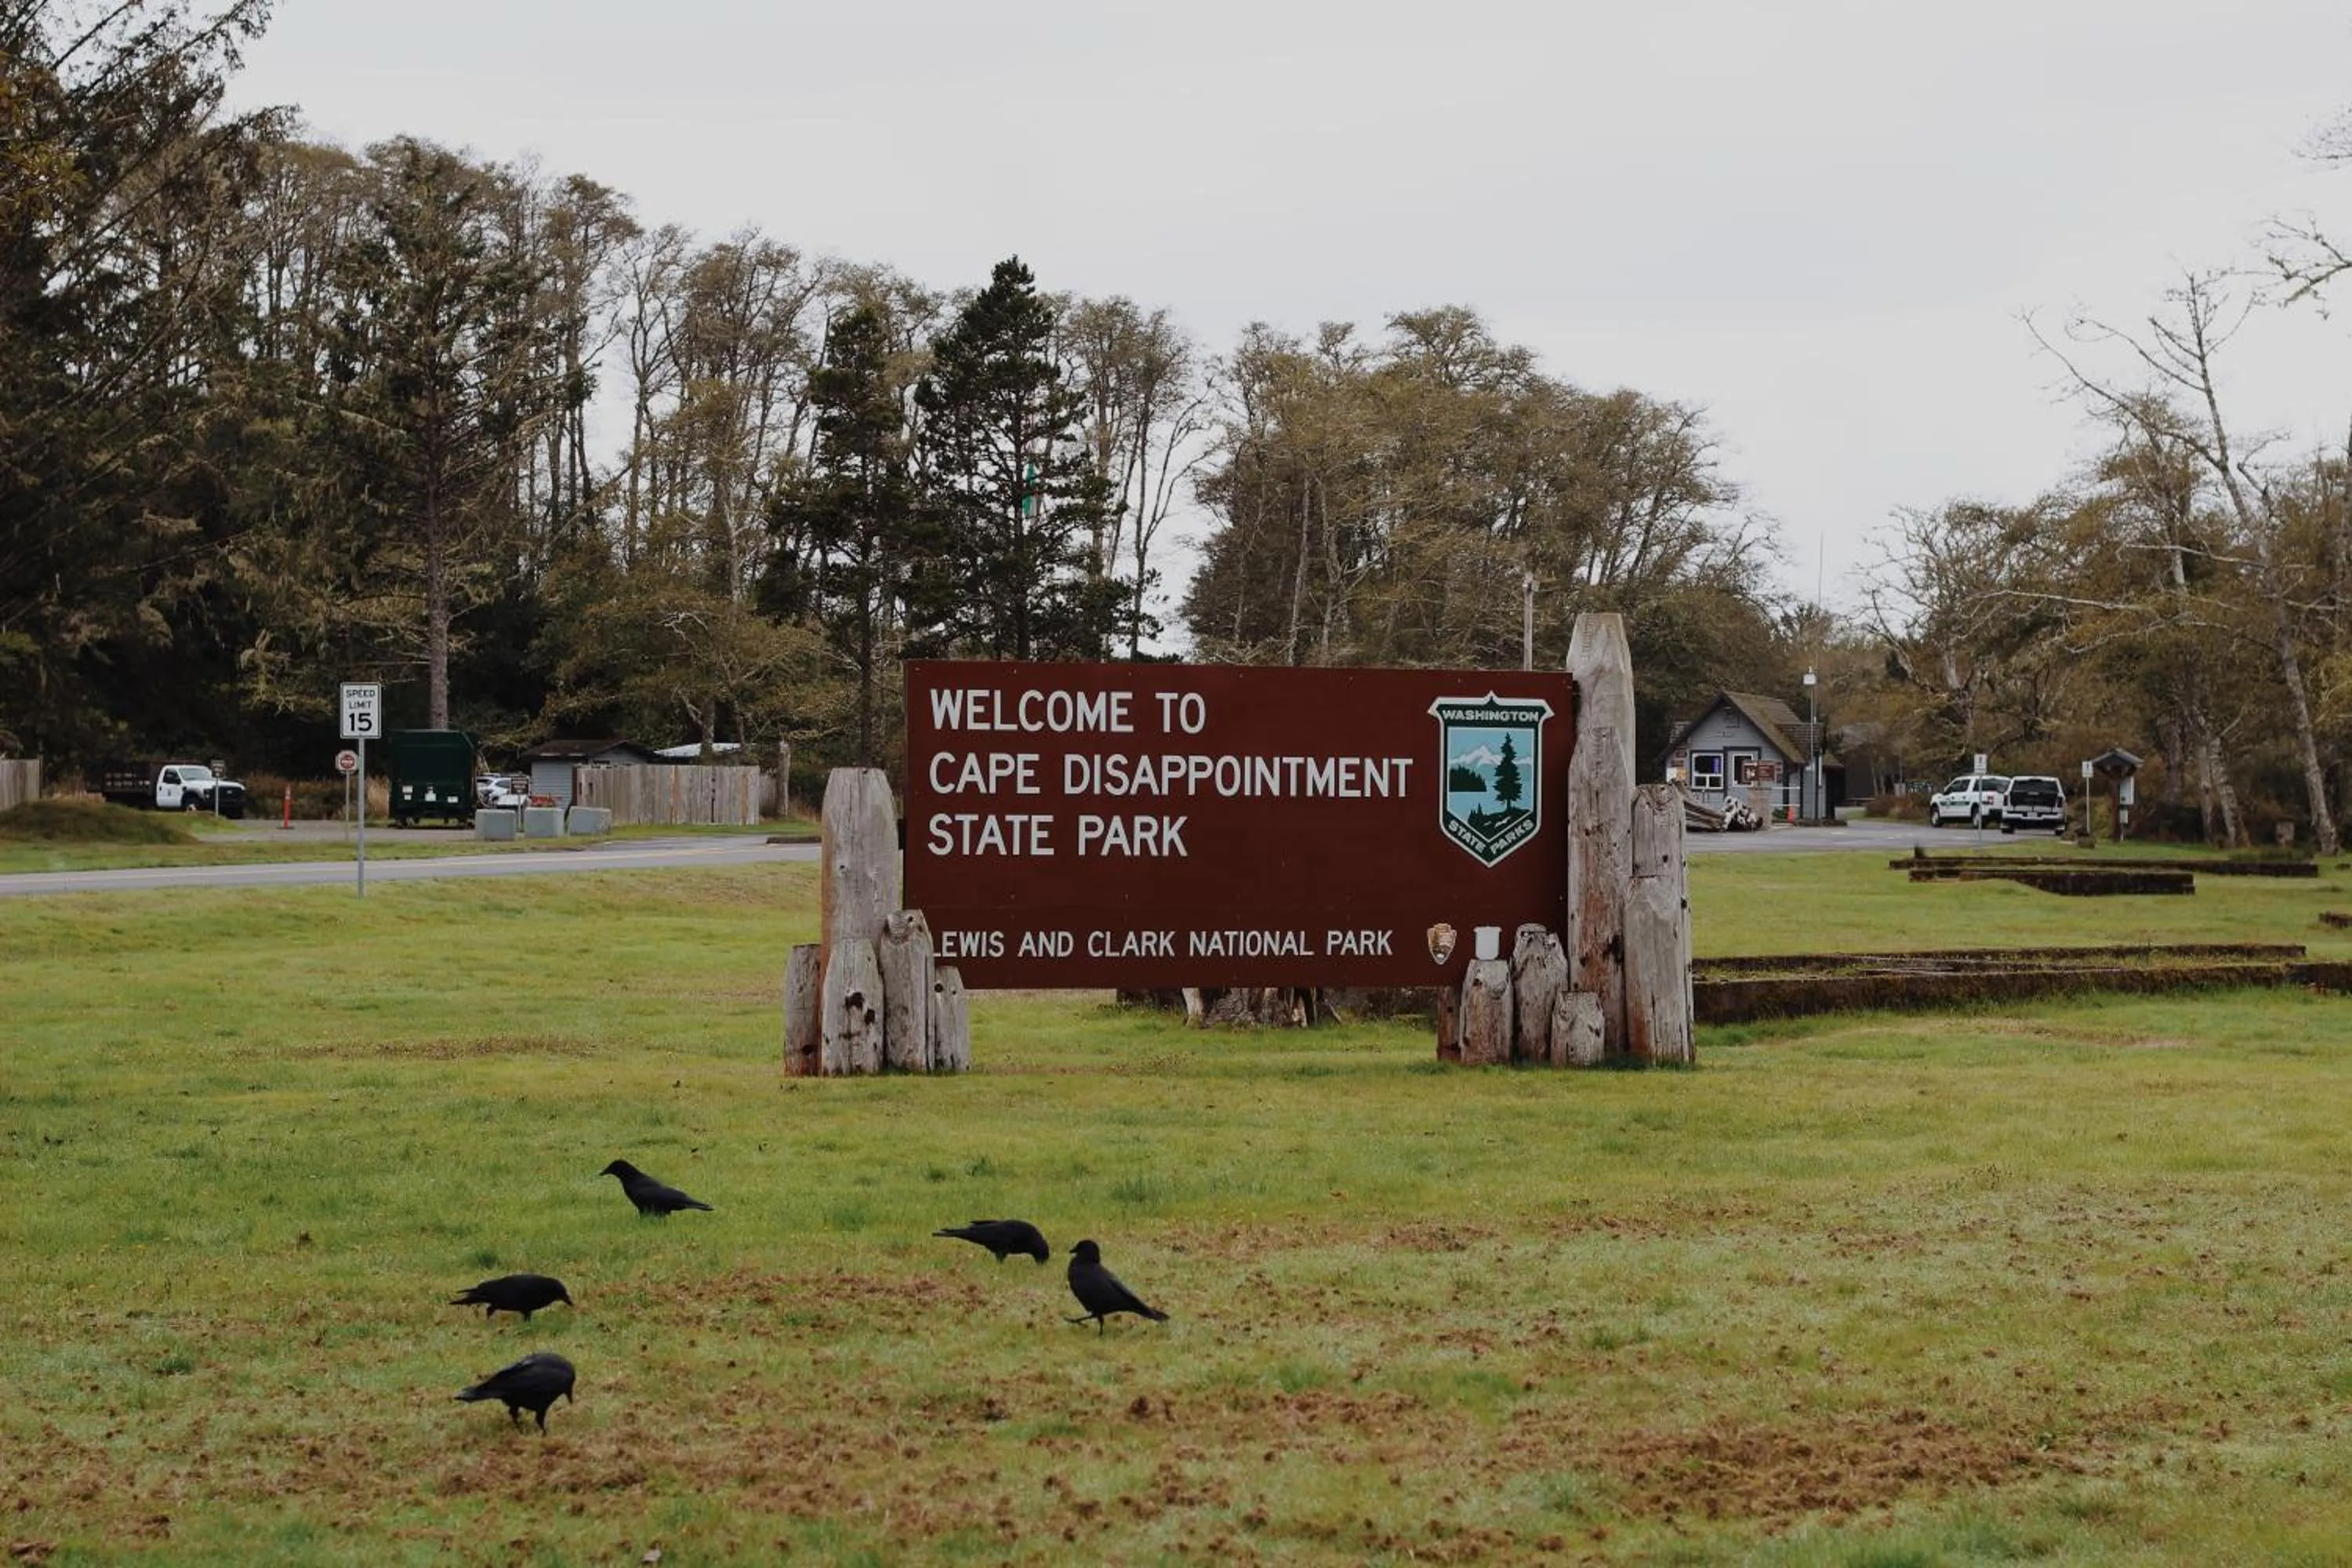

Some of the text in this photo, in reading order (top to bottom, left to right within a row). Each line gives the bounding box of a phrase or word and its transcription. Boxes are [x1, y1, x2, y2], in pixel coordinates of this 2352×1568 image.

[346, 689, 375, 698] SPEED
[349, 701, 372, 710] LIMIT
[349, 713, 372, 731] 15
[930, 688, 1206, 734] WELCOME TO
[1442, 710, 1539, 722] WASHINGTON
[929, 752, 1414, 797] CAPE DISAPPOINTMENT
[927, 813, 1188, 857] STATE PARK
[1448, 819, 1534, 854] STATE PARKS
[1018, 931, 1074, 957] AND
[1087, 931, 1175, 957] CLARK
[1189, 930, 1314, 956] NATIONAL
[1327, 930, 1393, 956] PARK
